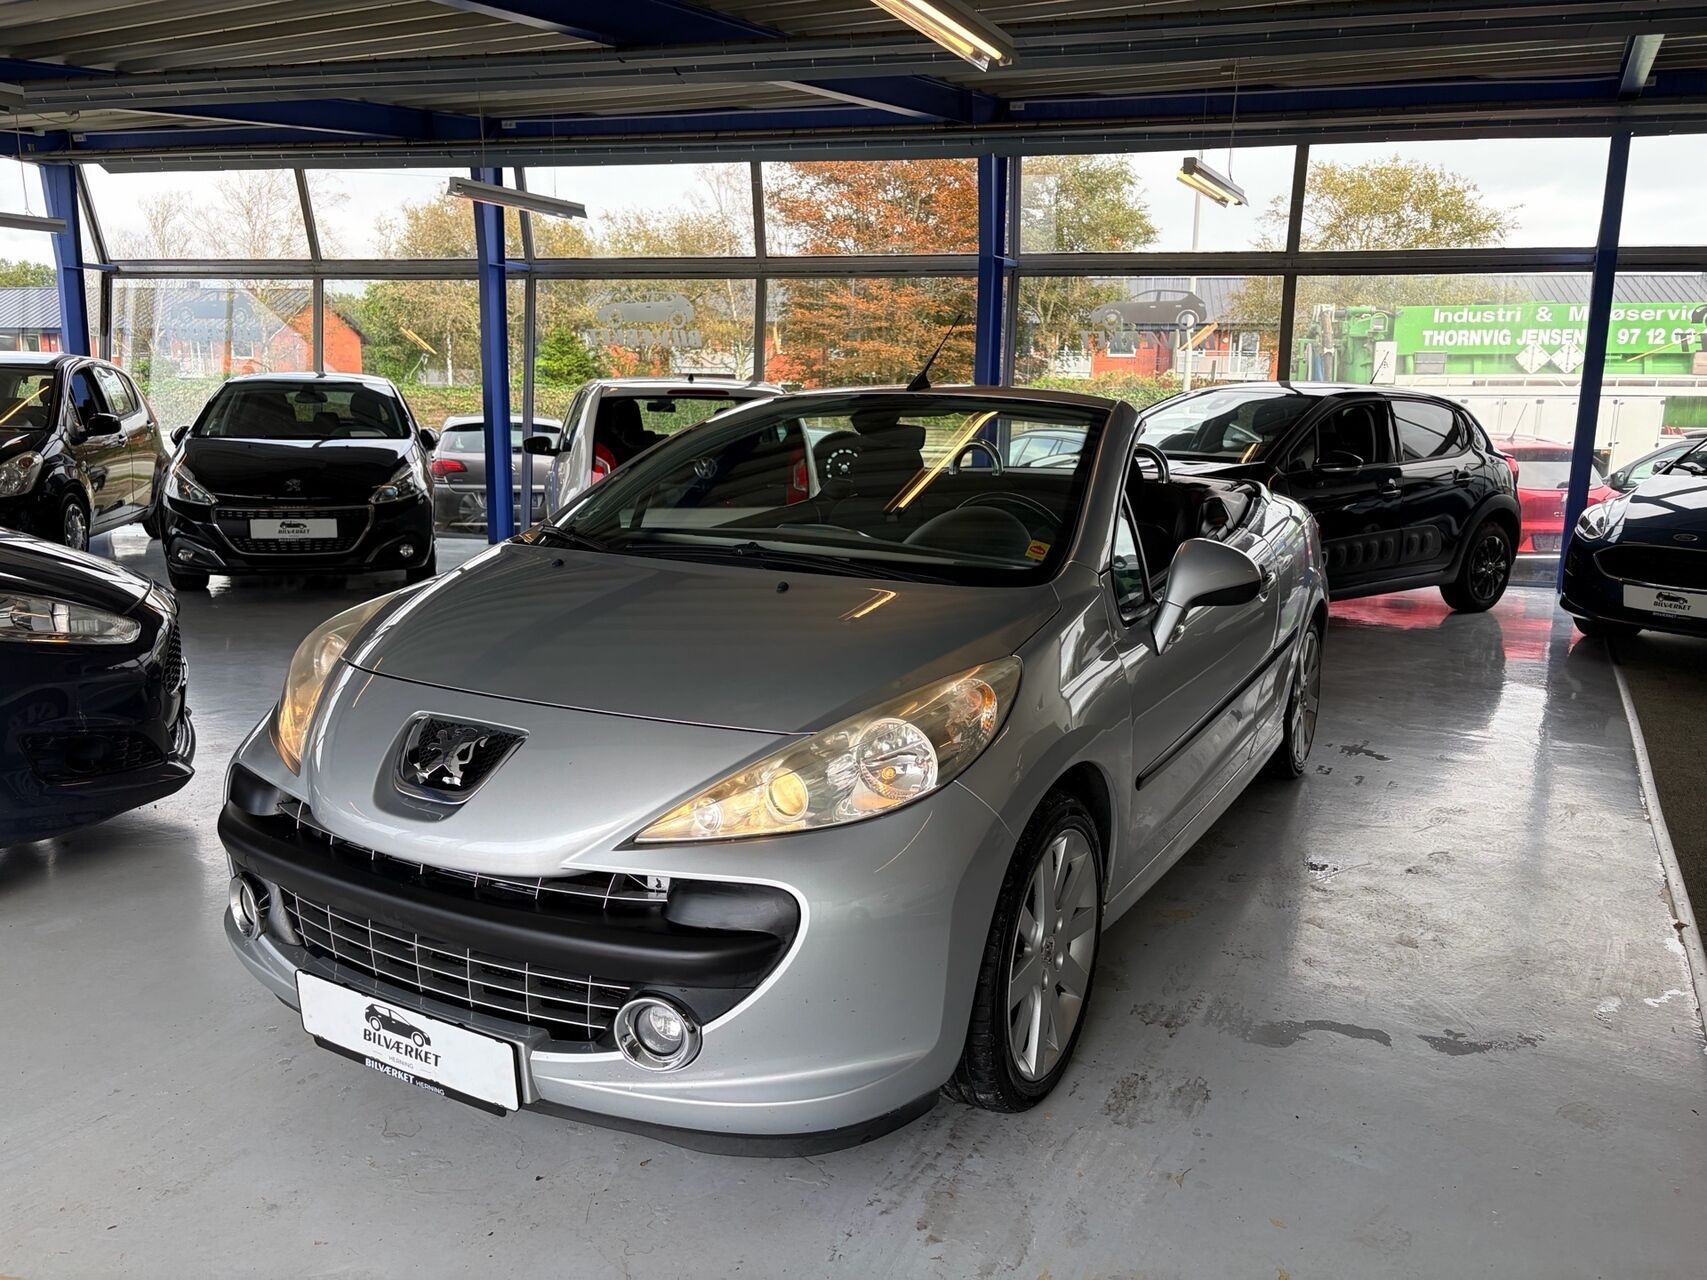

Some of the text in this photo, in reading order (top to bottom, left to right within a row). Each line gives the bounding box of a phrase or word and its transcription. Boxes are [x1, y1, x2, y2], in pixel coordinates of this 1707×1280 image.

[1433, 307, 1521, 323] Industri
[1535, 306, 1553, 322] &
[1422, 329, 1512, 346] THORNVIG
[1516, 328, 1587, 346] JENSEN
[1616, 328, 1641, 345] 97
[1645, 328, 1666, 345] 12
[363, 1028, 441, 1067] BILVÆRKET
[389, 1055, 414, 1069] HERNING
[365, 1058, 445, 1096] BILVÆRKET HERNING
